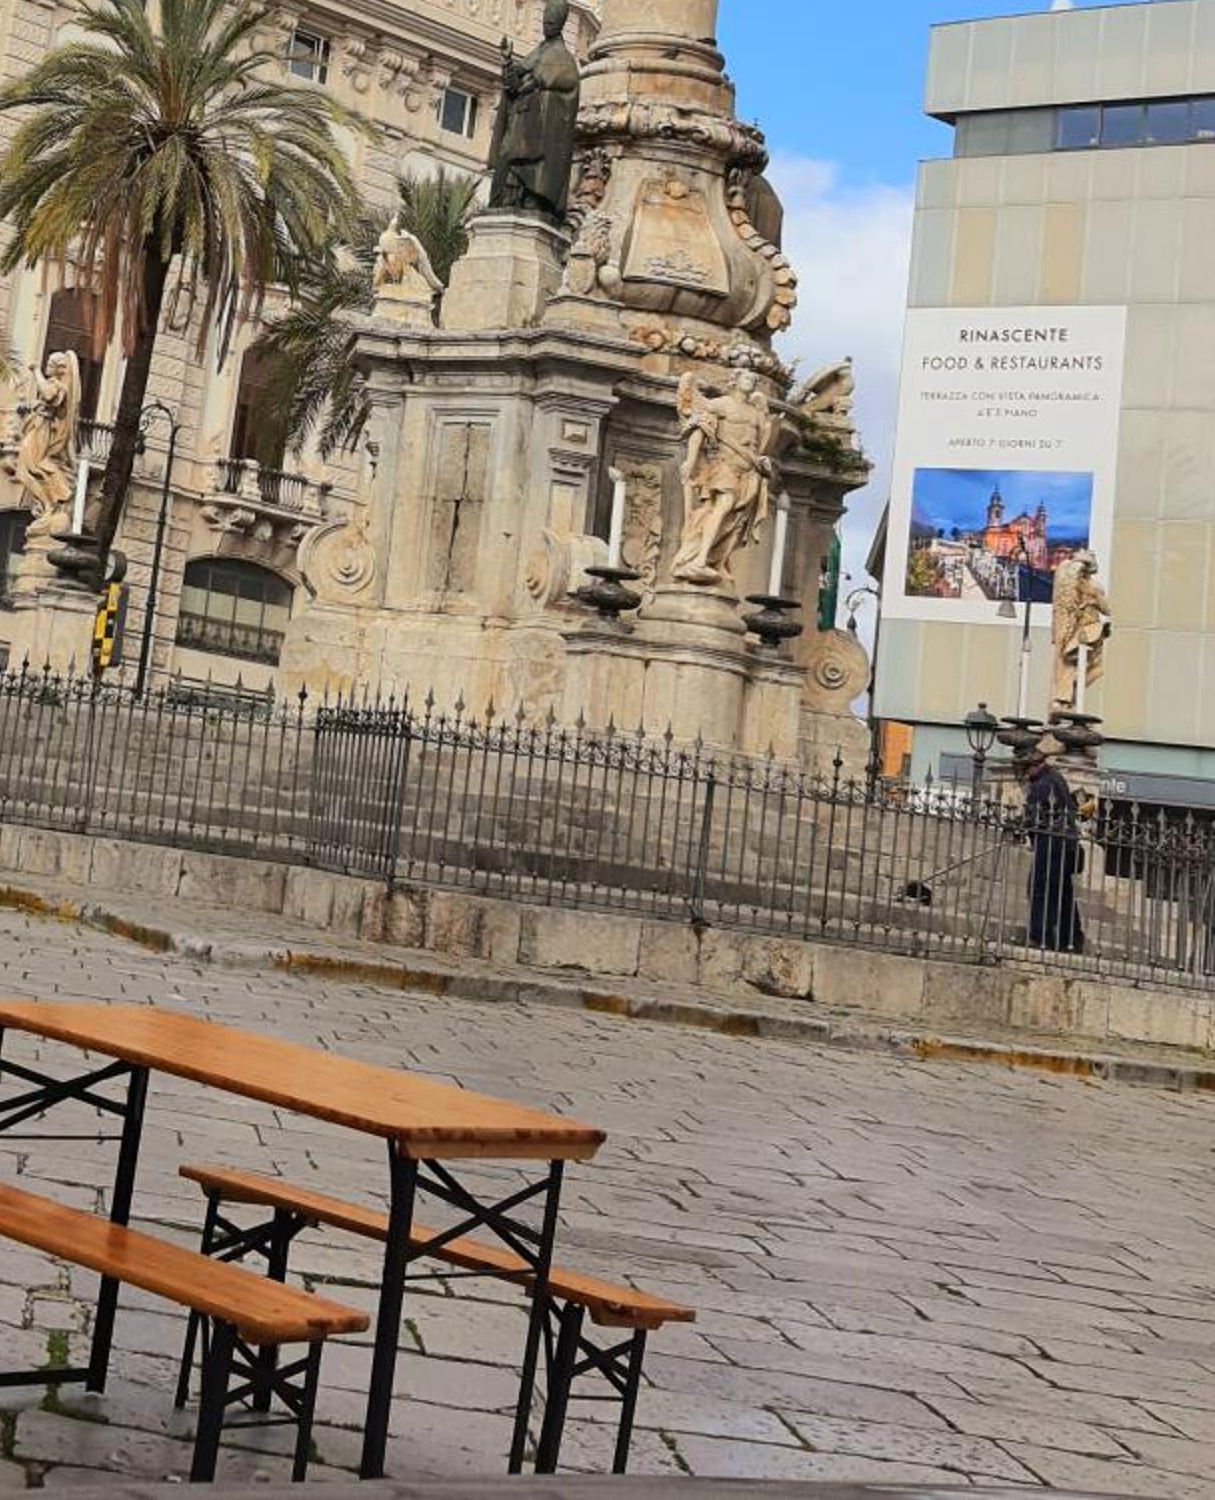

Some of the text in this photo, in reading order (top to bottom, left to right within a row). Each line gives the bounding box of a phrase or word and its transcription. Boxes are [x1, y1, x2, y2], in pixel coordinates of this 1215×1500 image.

[959, 328, 1068, 342] RINASCENTE
[922, 356, 1104, 371] FOOD & RESTAURANTS
[920, 391, 968, 401] TERRAZZA
[970, 392, 995, 401] CON
[998, 391, 1025, 401] VISTA
[1004, 408, 1038, 417] PIANO
[948, 438, 985, 448] APERTO
[998, 439, 1036, 448] GIORNI
